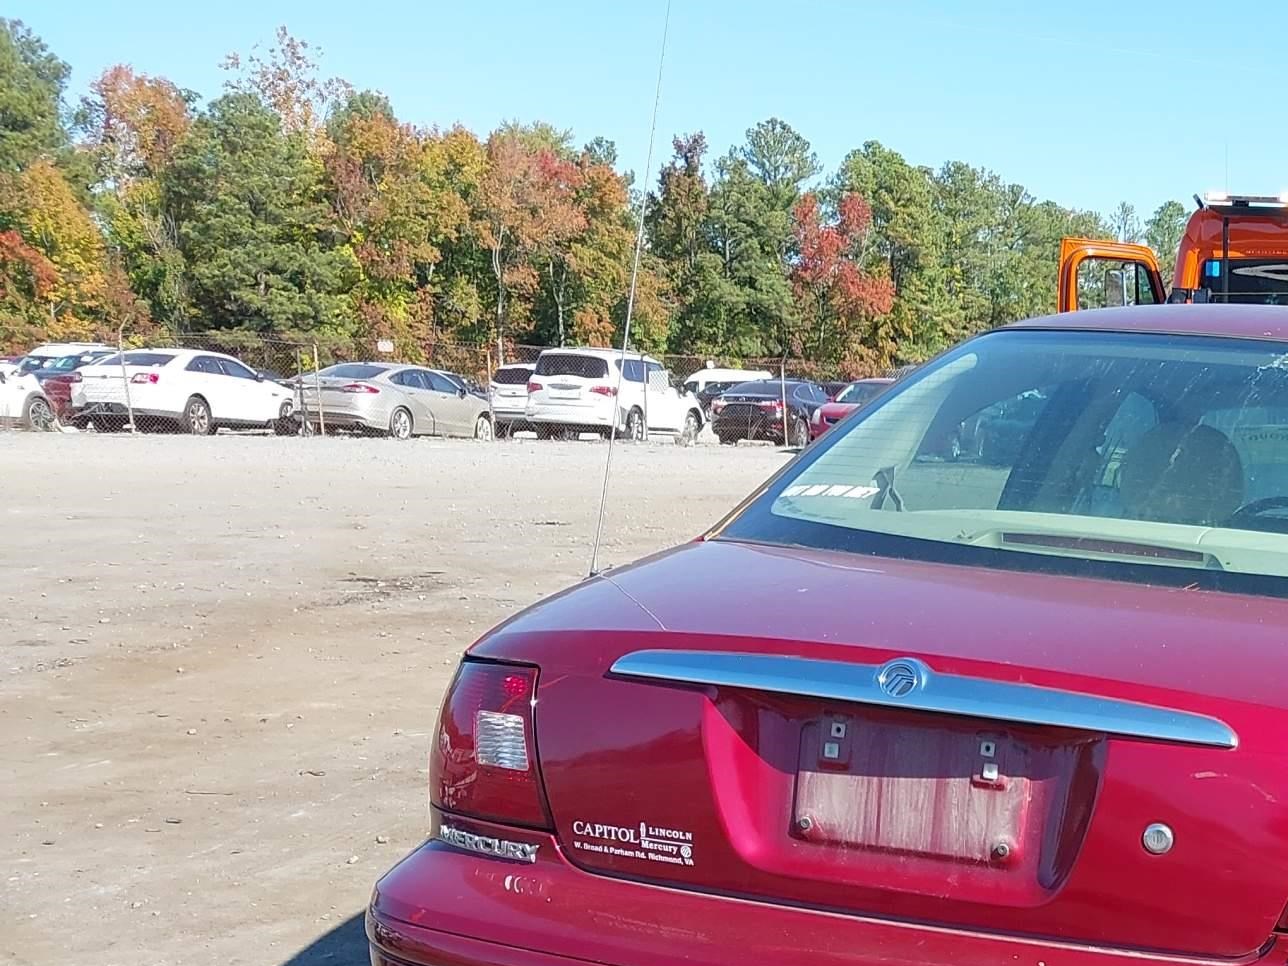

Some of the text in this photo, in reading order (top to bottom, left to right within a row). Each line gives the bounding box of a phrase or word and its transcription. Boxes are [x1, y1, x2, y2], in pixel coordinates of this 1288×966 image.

[573, 820, 640, 844] CAPITOL
[648, 826, 693, 841] LINCOLN
[440, 825, 540, 864] MERCURY
[573, 841, 583, 849] W.
[683, 858, 694, 866] VA
[641, 839, 678, 855] Mercury
